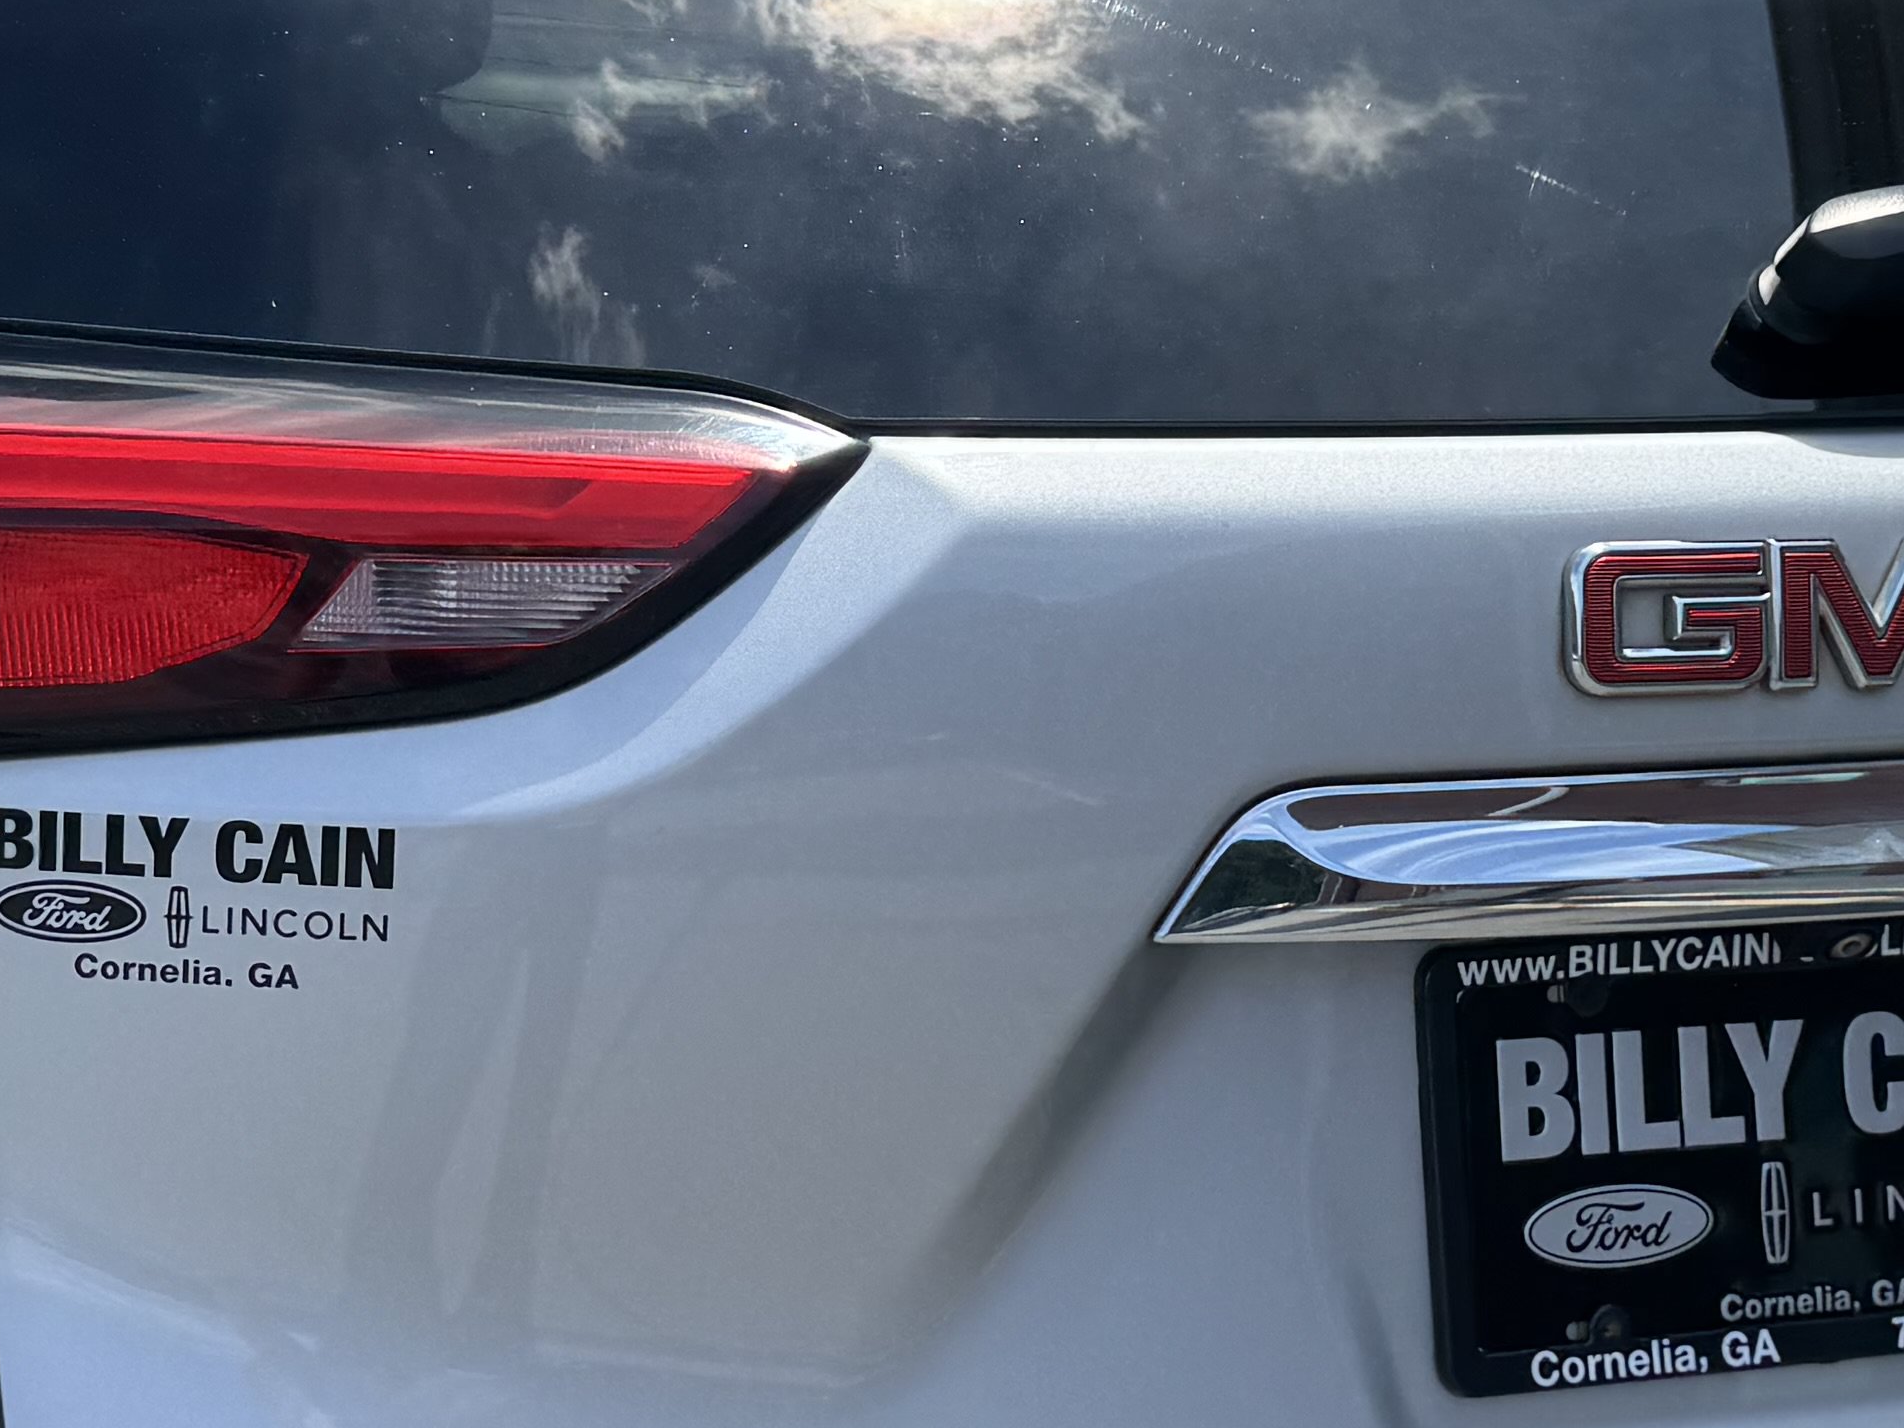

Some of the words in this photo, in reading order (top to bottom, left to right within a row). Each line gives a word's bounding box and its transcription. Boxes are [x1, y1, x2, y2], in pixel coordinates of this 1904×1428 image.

[215, 820, 396, 889] CAIN
[22, 891, 110, 932] Ford
[201, 905, 389, 942] LINCOLN
[249, 963, 299, 989] GA
[1496, 1019, 1804, 1163] BILLY
[1566, 1201, 1672, 1253] Ford
[1720, 1285, 1861, 1322] Cornelia,
[1531, 1339, 1708, 1387] Cornelia,
[1721, 1329, 1781, 1367] GA
